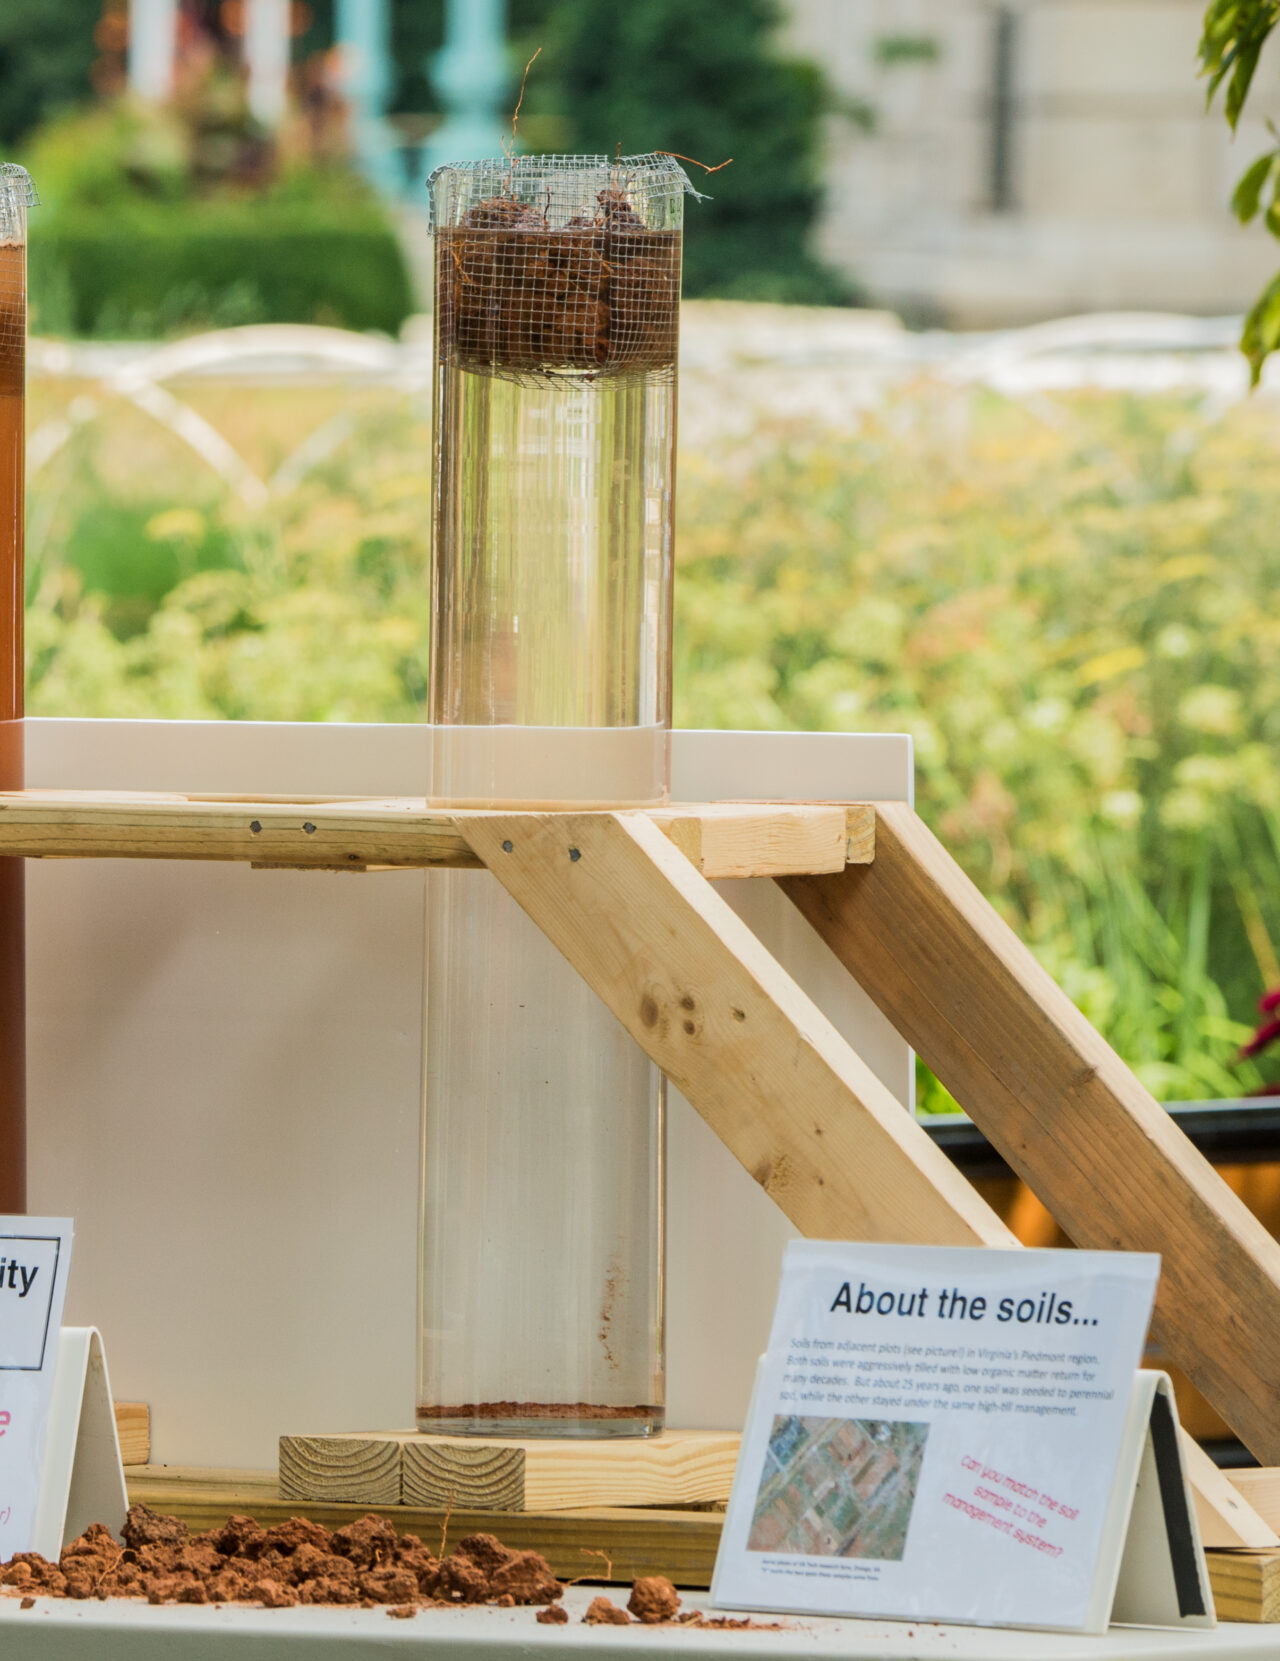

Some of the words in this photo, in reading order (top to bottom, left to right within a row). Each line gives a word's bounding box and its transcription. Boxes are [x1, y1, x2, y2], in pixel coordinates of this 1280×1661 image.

[830, 1281, 928, 1318] About
[938, 1287, 988, 1321] the
[996, 1292, 1099, 1327] soils...
[960, 1455, 982, 1473] Can
[1002, 1477, 1038, 1500] match
[1038, 1493, 1059, 1511] the
[1058, 1504, 1080, 1521] soil
[974, 1486, 1013, 1511] sample
[1013, 1504, 1027, 1518] to
[1027, 1510, 1047, 1528] the
[943, 1492, 1014, 1535] management
[1013, 1528, 1063, 1558] system?
